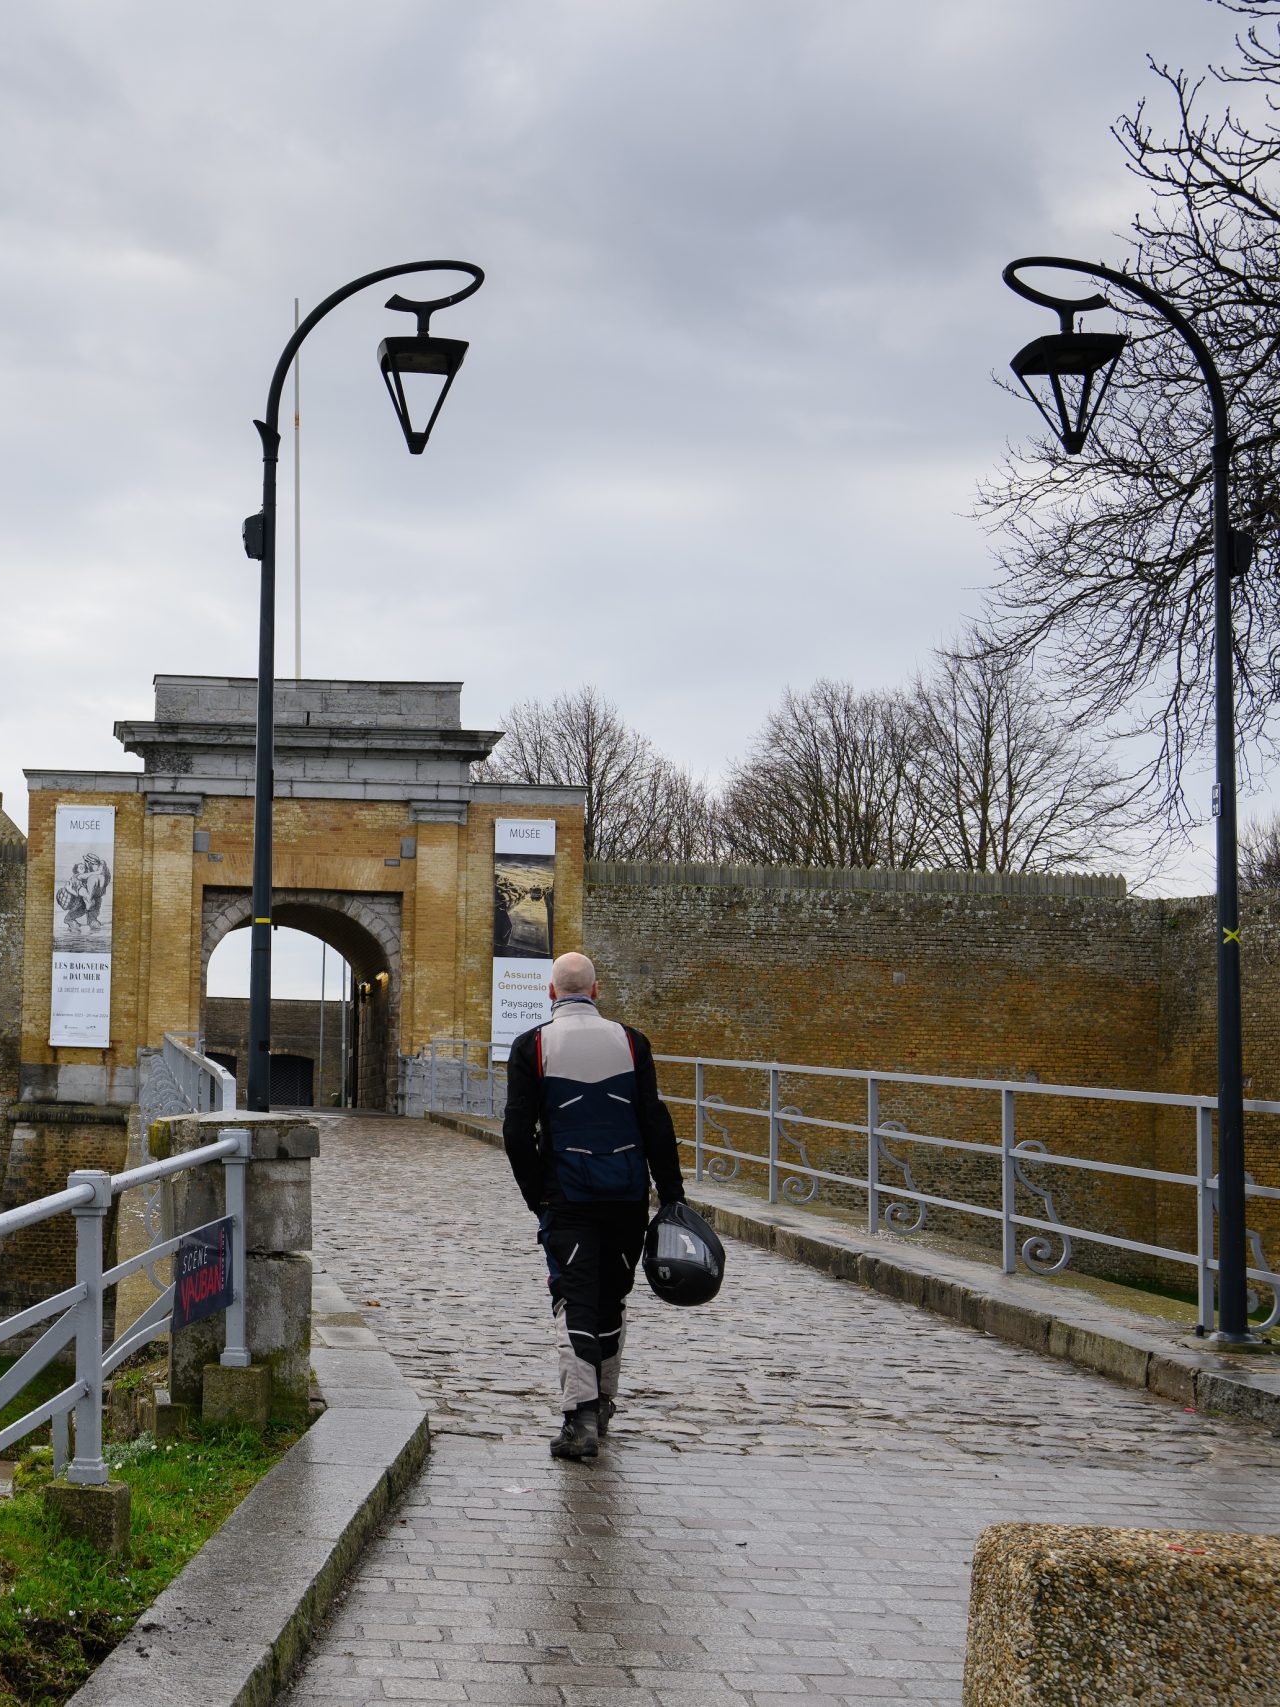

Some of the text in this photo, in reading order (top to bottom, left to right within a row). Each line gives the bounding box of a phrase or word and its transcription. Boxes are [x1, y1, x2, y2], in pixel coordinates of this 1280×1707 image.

[70, 819, 100, 830] MUSÉE
[510, 828, 540, 838] MUSÉE
[70, 962, 109, 970] BAIGNEURS
[504, 971, 541, 979] Assunta
[498, 982, 547, 991] Genovesio
[501, 999, 543, 1010] Paysages
[502, 1011, 542, 1020] des Forts
[182, 1245, 208, 1274] SCÈNE
[181, 1232, 223, 1320] VAUBAN
